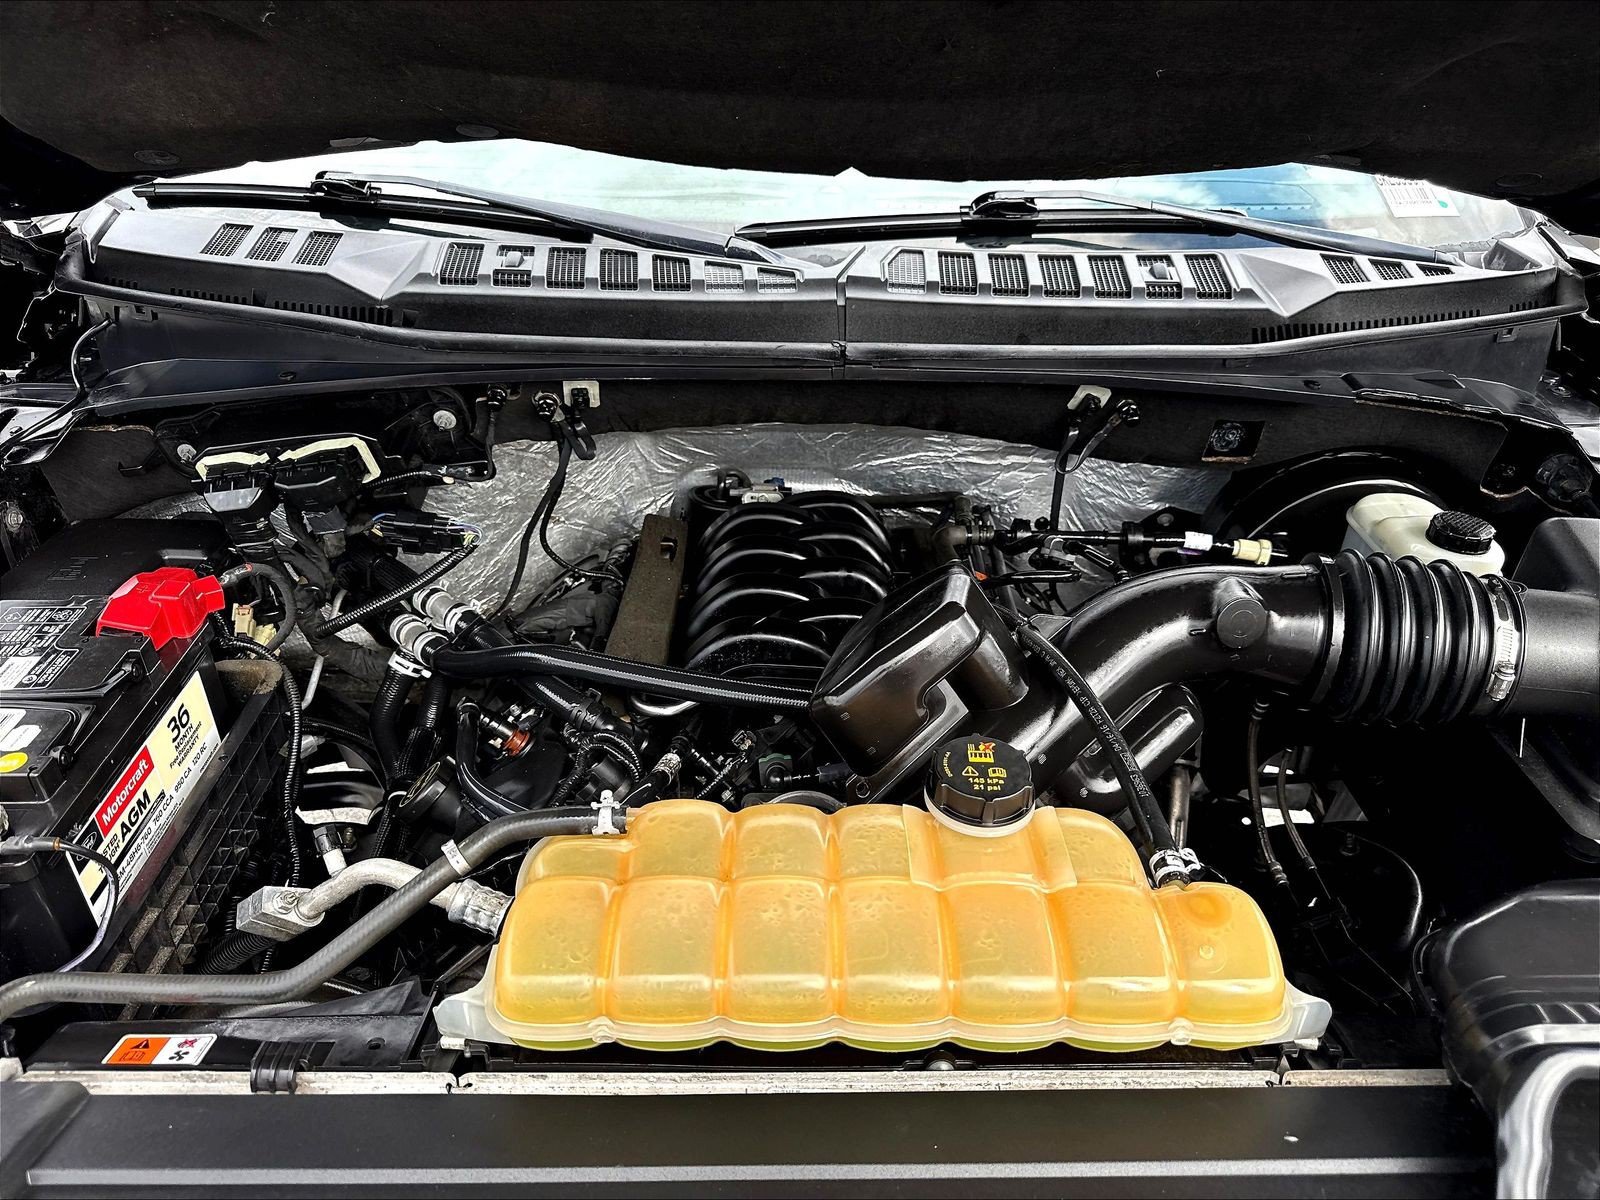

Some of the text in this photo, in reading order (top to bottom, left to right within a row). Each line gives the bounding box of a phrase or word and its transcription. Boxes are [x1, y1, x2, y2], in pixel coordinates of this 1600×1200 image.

[166, 702, 190, 744] 36
[169, 720, 202, 769] Free Replacement
[174, 723, 194, 752] MONTH
[177, 734, 199, 768] WARRANTY
[101, 756, 148, 826] Motorcraft
[153, 809, 163, 826] 760
[162, 793, 174, 811] CCA
[174, 777, 185, 794] 950
[184, 765, 192, 779] CA
[199, 742, 208, 755] RC
[118, 788, 151, 842] AGM
